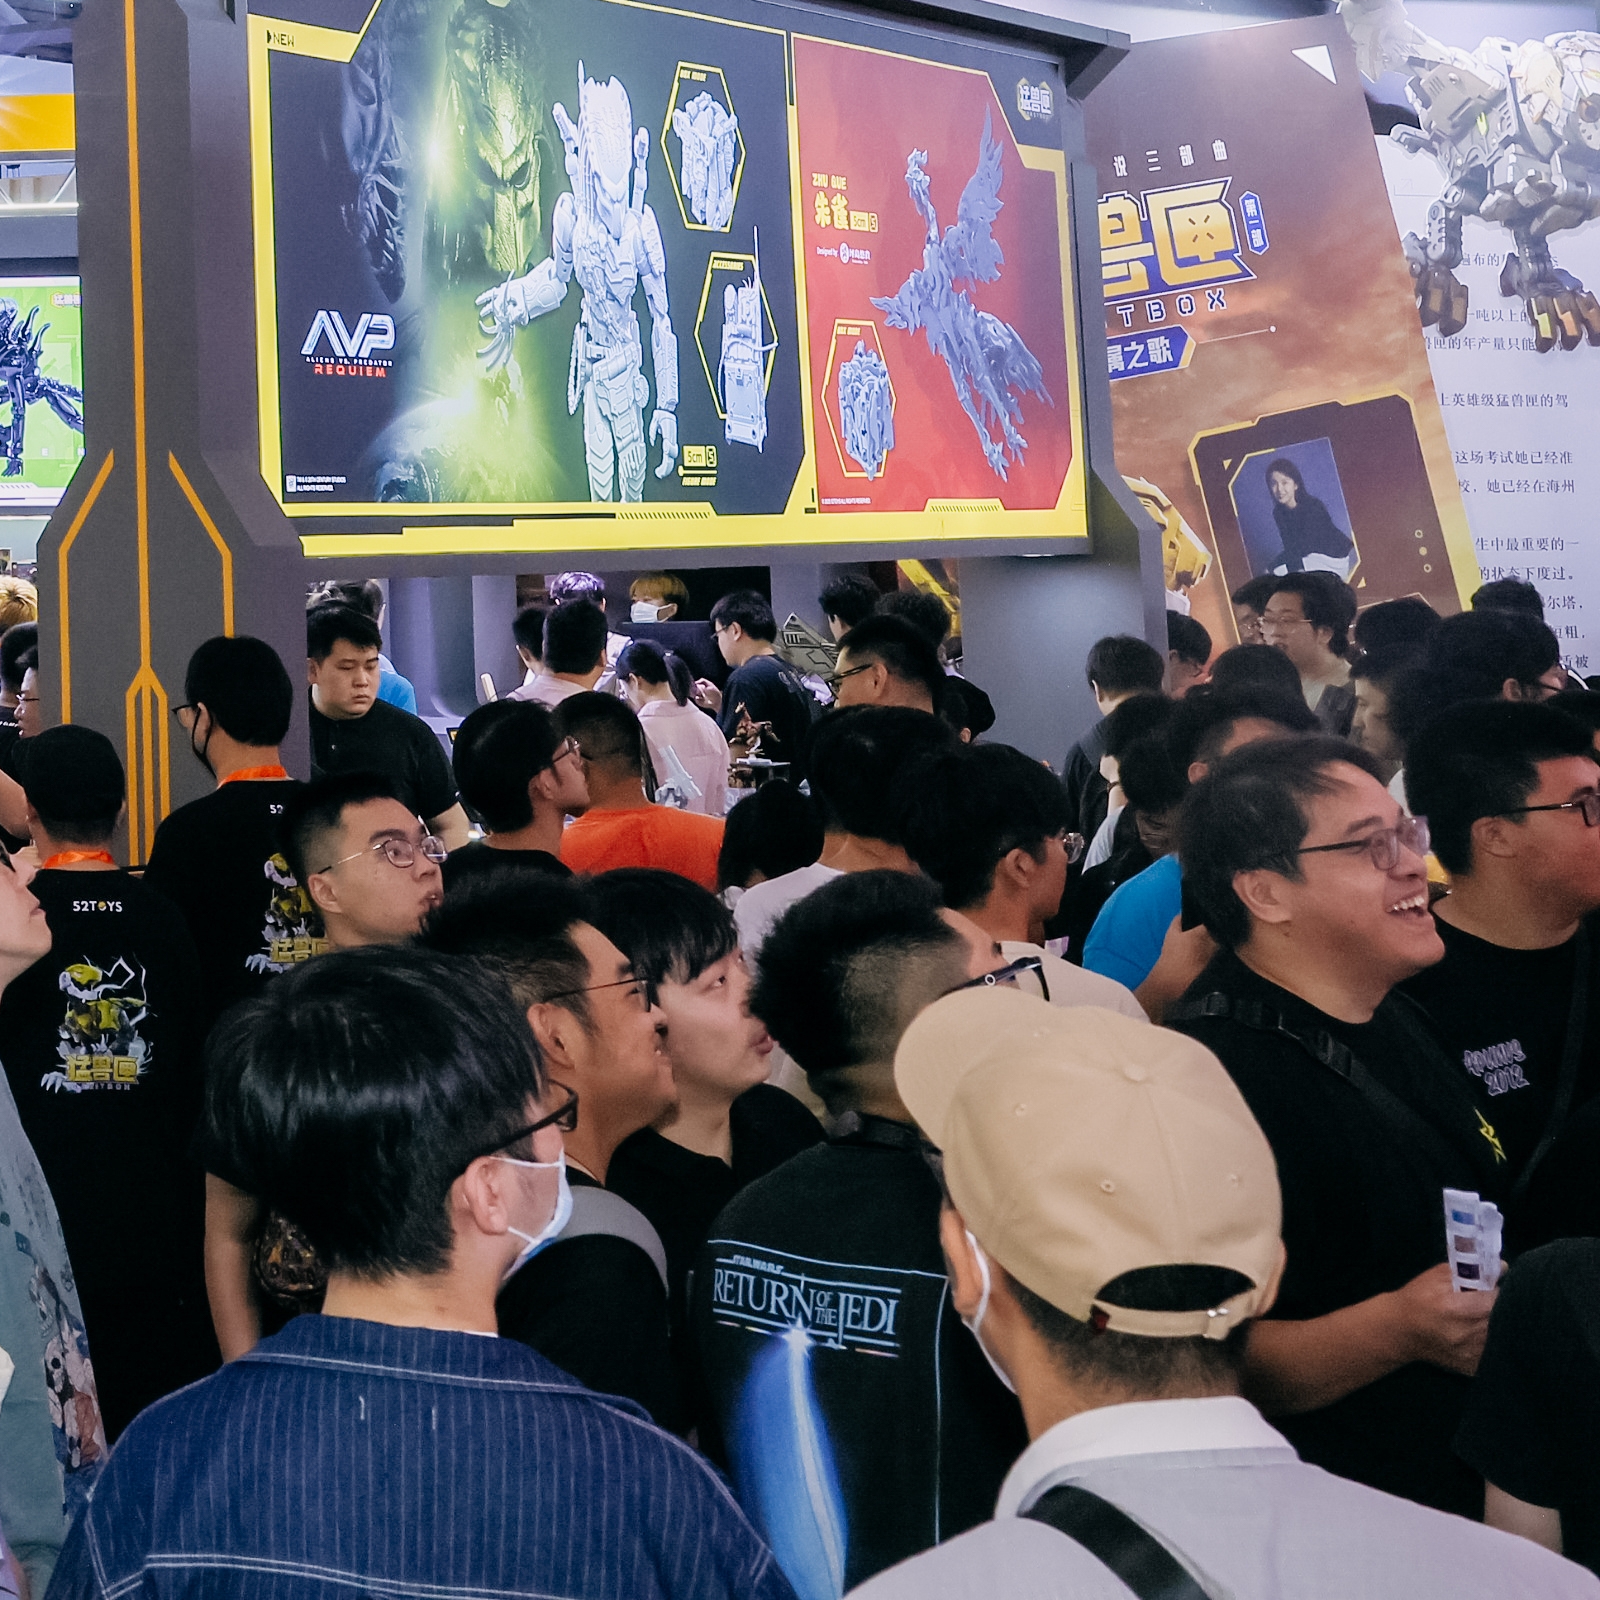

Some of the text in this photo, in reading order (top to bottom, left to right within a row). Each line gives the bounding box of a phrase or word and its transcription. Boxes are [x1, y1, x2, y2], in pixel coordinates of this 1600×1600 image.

[273, 34, 294, 47] NEW
[1019, 84, 1051, 114] 猛兽匣
[812, 173, 829, 188] ZHU
[814, 191, 849, 230] 朱雀
[853, 215, 867, 228] 5cm
[1245, 198, 1264, 248] 第一部
[301, 309, 397, 358] AVP
[314, 364, 387, 378] REQUIEM
[354, 359, 393, 367] PREDATOR
[687, 451, 703, 463] 5cm
[1455, 451, 1573, 464] 这场考试她已经准
[73, 901, 123, 912] 52TOYS
[66, 1055, 139, 1083] 猛兽匣
[713, 1268, 815, 1322] RETURN
[816, 1291, 833, 1308] OF
[815, 1307, 837, 1325] THE
[837, 1292, 899, 1346] JEDI
